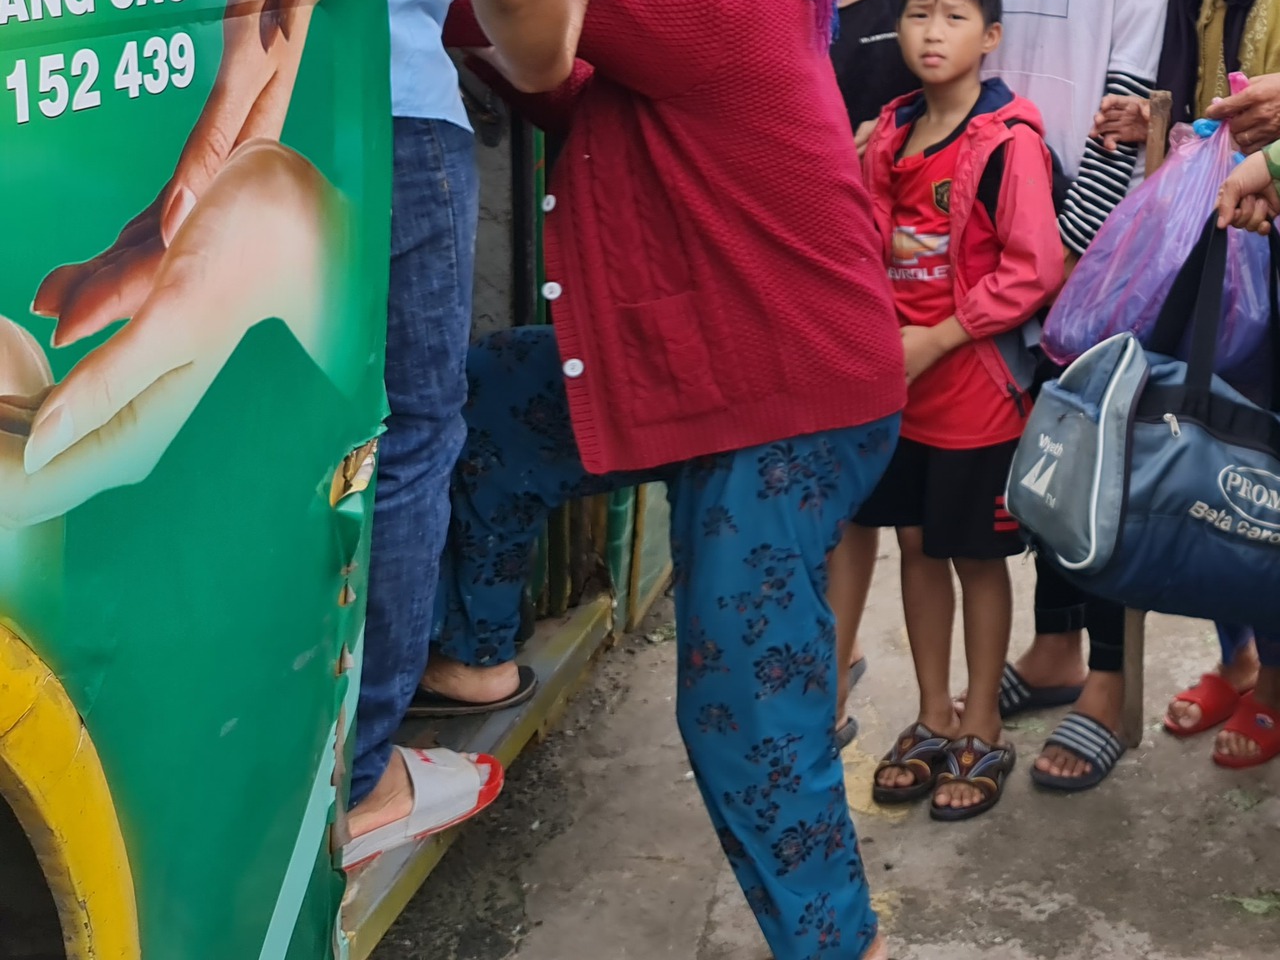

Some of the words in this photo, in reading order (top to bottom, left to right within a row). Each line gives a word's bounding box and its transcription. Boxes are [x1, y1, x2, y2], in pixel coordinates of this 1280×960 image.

[6, 48, 101, 125] 152
[114, 32, 196, 99] 439
[1038, 433, 1064, 457] Wyeth
[1188, 500, 1233, 531] Beta
